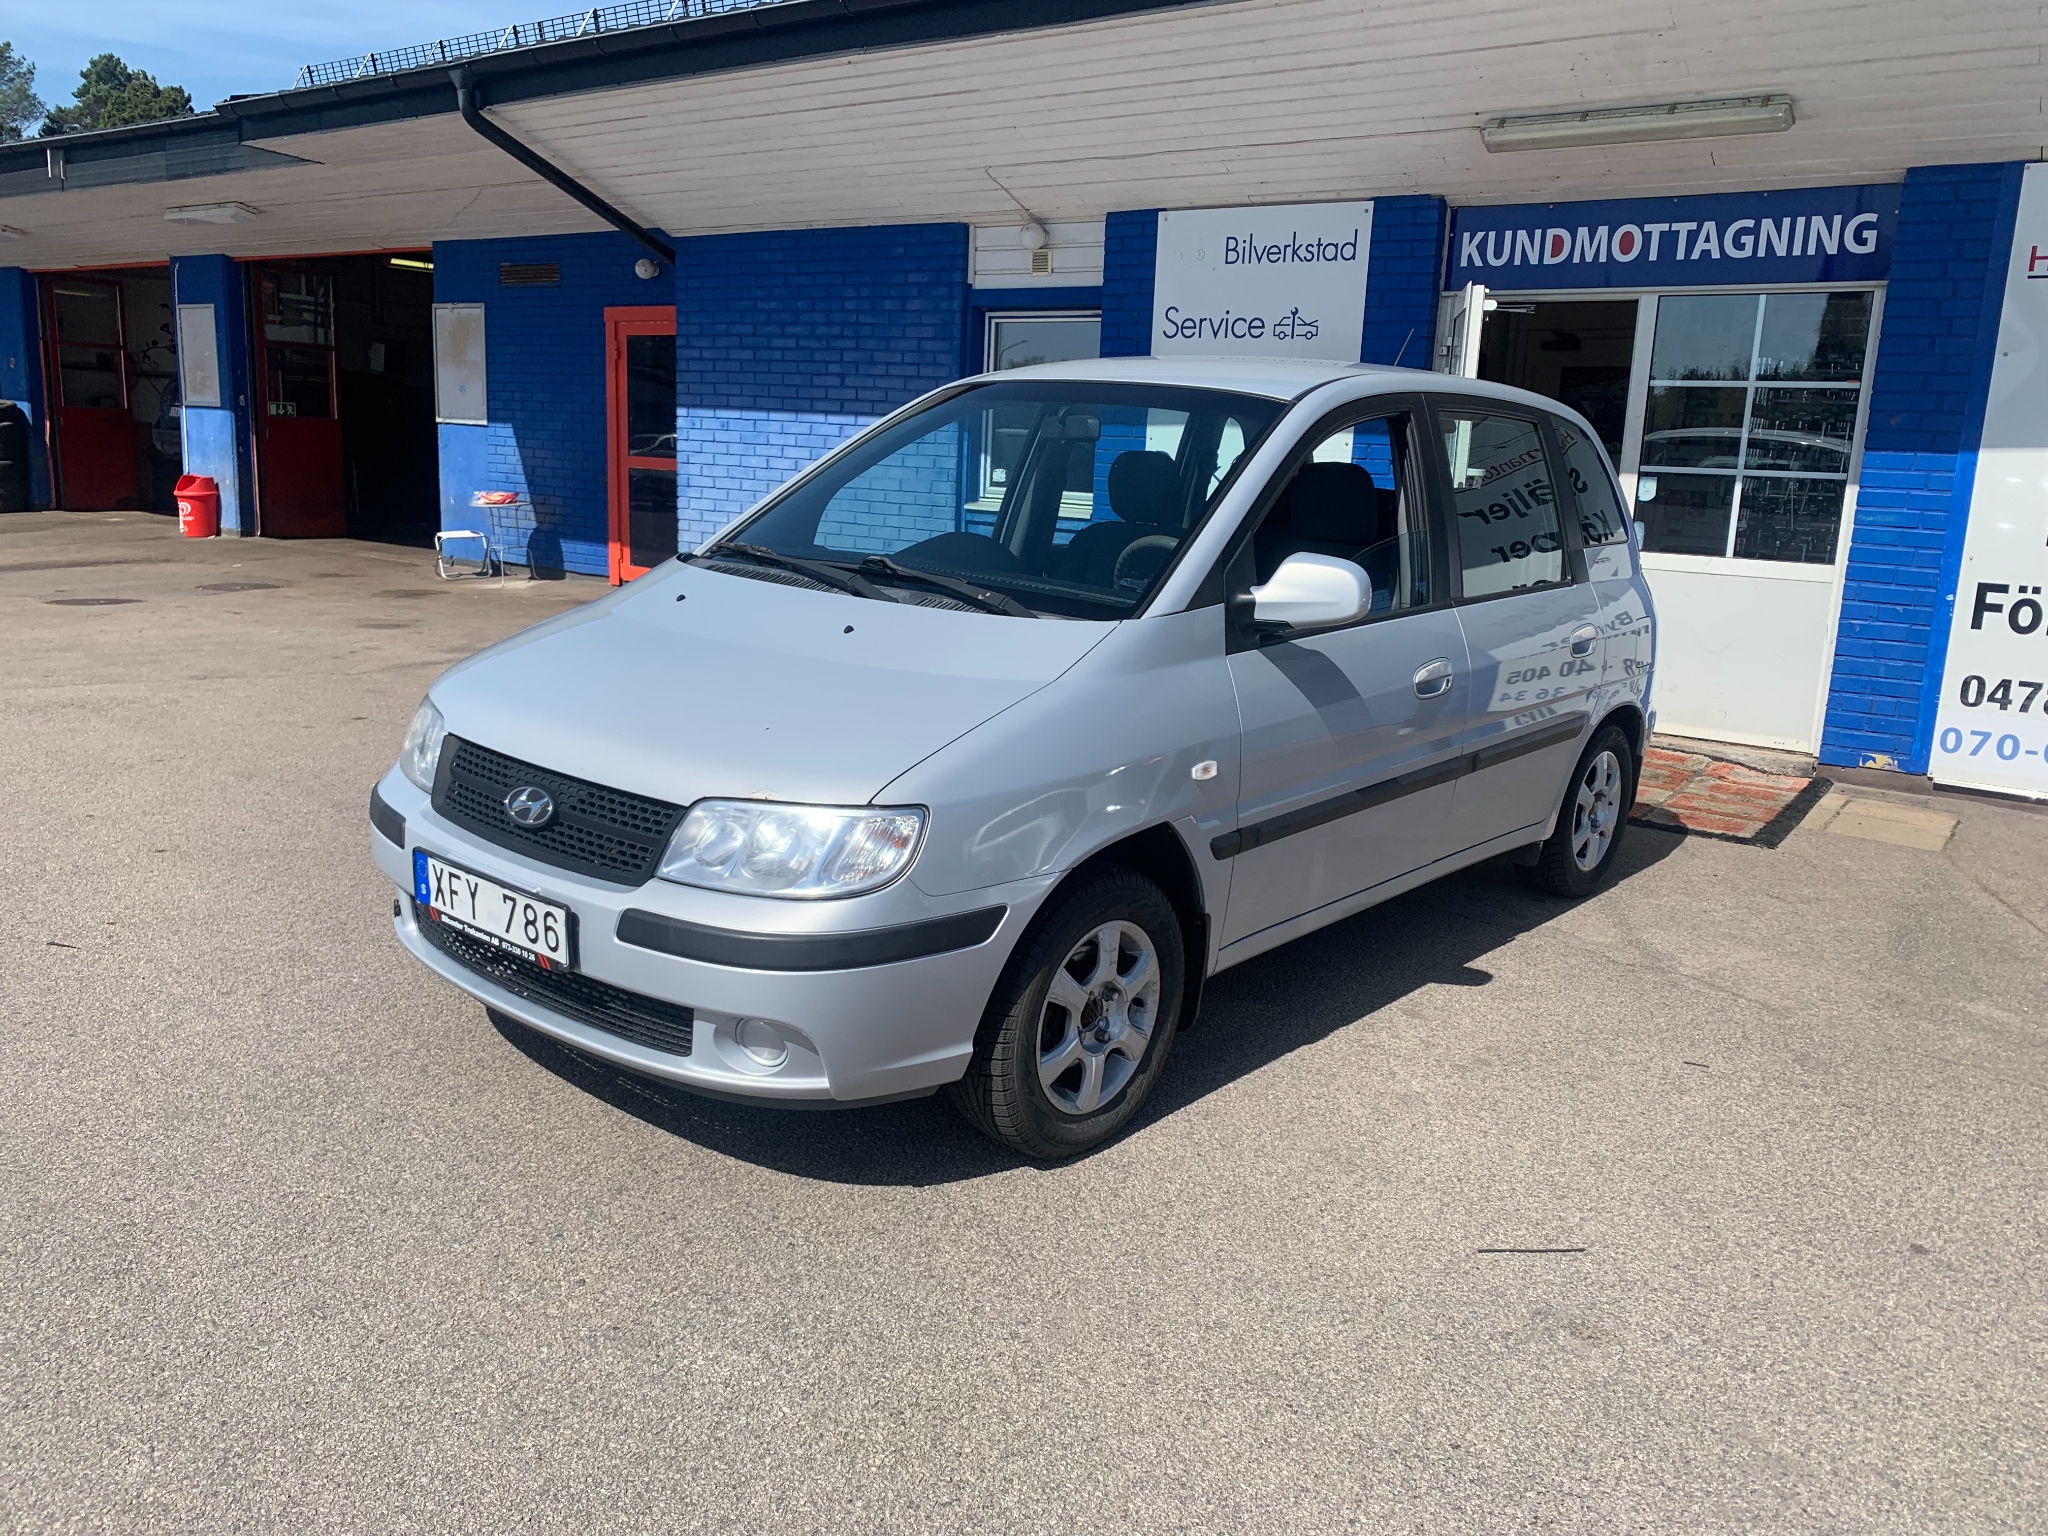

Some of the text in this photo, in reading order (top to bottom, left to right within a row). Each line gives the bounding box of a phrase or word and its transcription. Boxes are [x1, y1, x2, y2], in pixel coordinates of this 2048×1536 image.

[1224, 228, 1358, 265] Bilverkstad
[1459, 212, 1880, 268] KUNDMOTTAGNING
[1162, 305, 1266, 340] Service
[1970, 581, 2048, 636] Fö
[1959, 674, 2048, 716] 047
[1939, 727, 2048, 765] 070-
[420, 883, 427, 895] S
[432, 863, 560, 953] XFY 786
